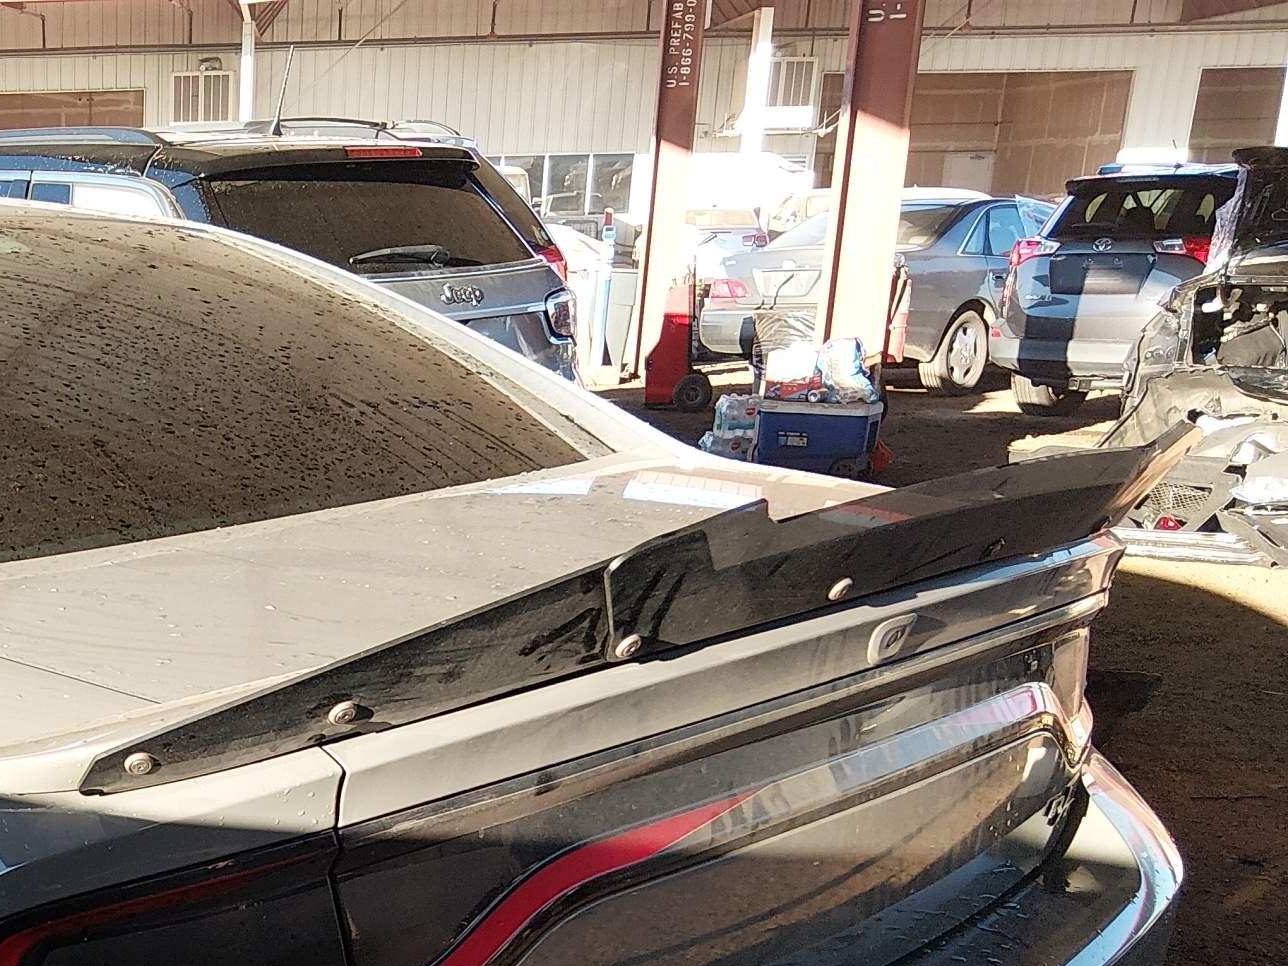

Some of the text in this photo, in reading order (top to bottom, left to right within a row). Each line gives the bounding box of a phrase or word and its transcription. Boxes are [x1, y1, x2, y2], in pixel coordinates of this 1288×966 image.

[666, 2, 684, 88] U.S. PREFAB
[440, 282, 484, 308] Jeep
